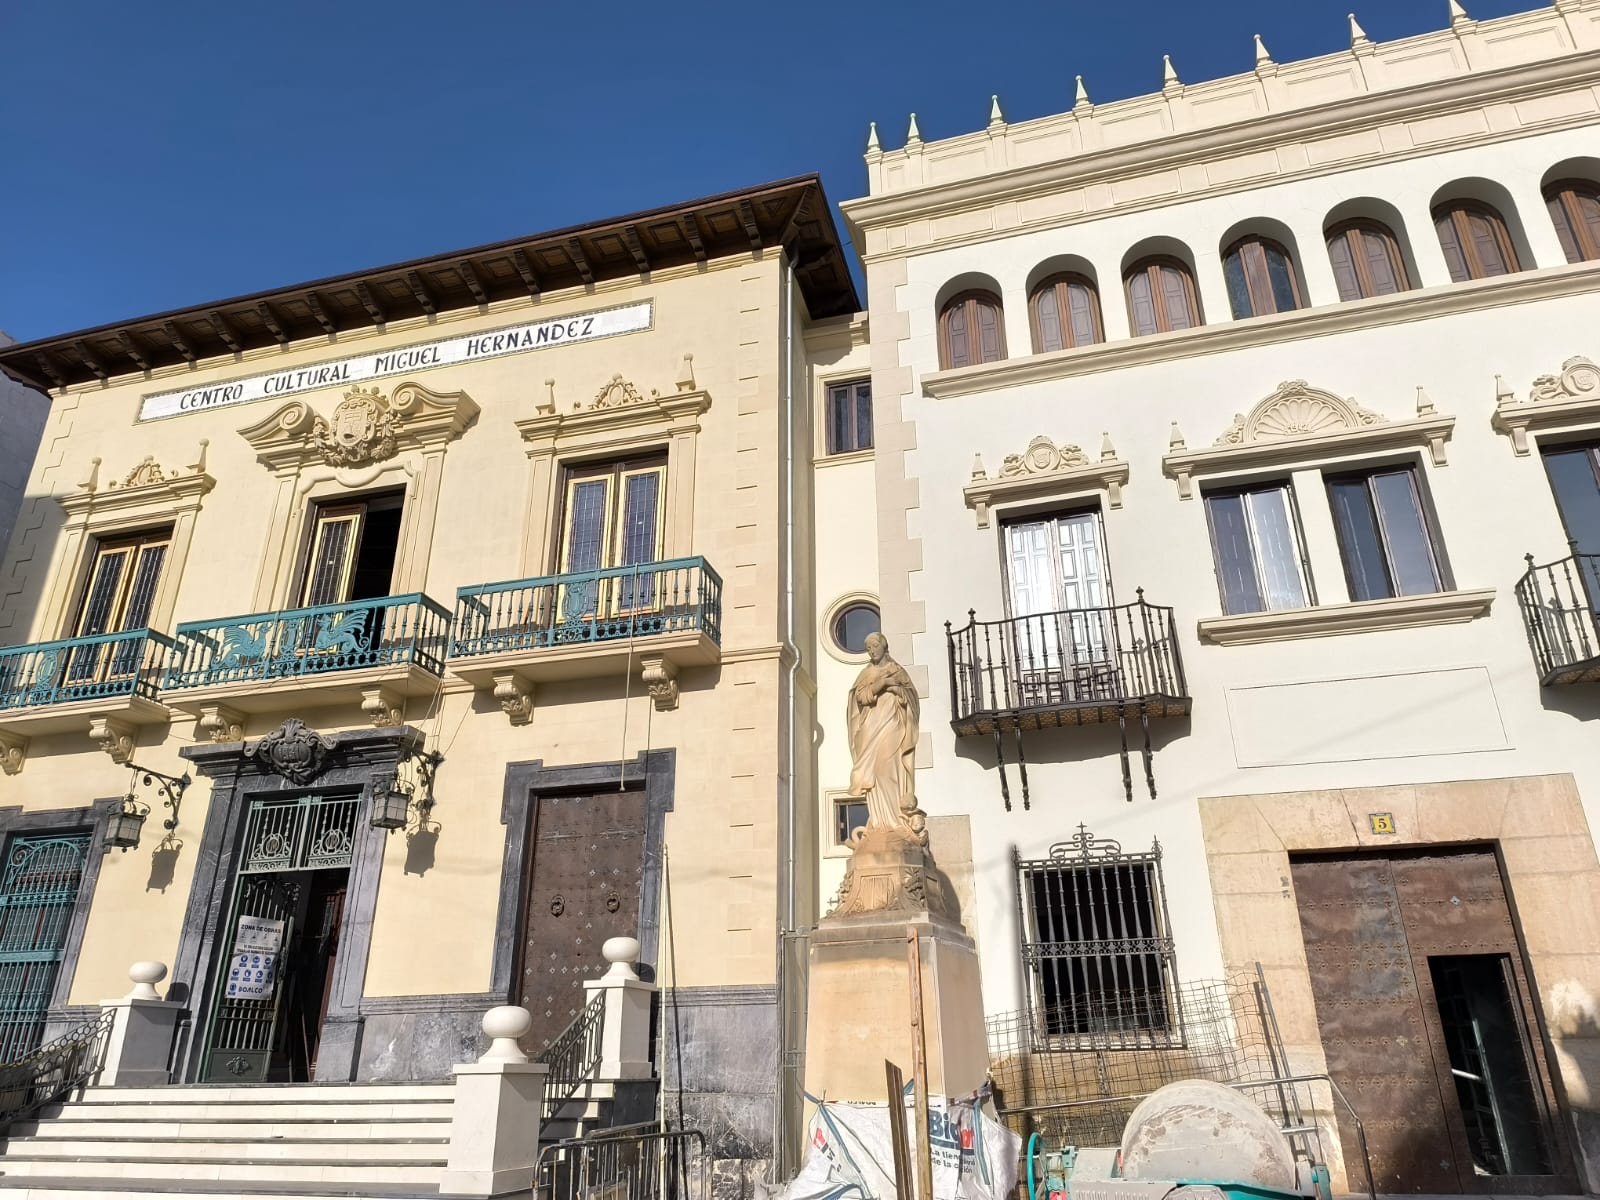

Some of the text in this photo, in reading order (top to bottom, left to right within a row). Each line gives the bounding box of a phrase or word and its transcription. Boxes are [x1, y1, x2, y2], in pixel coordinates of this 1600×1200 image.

[180, 317, 595, 410] CENTRO CULTURAL MIGUEL HERNANDEZ
[1378, 818, 1387, 830] 5
